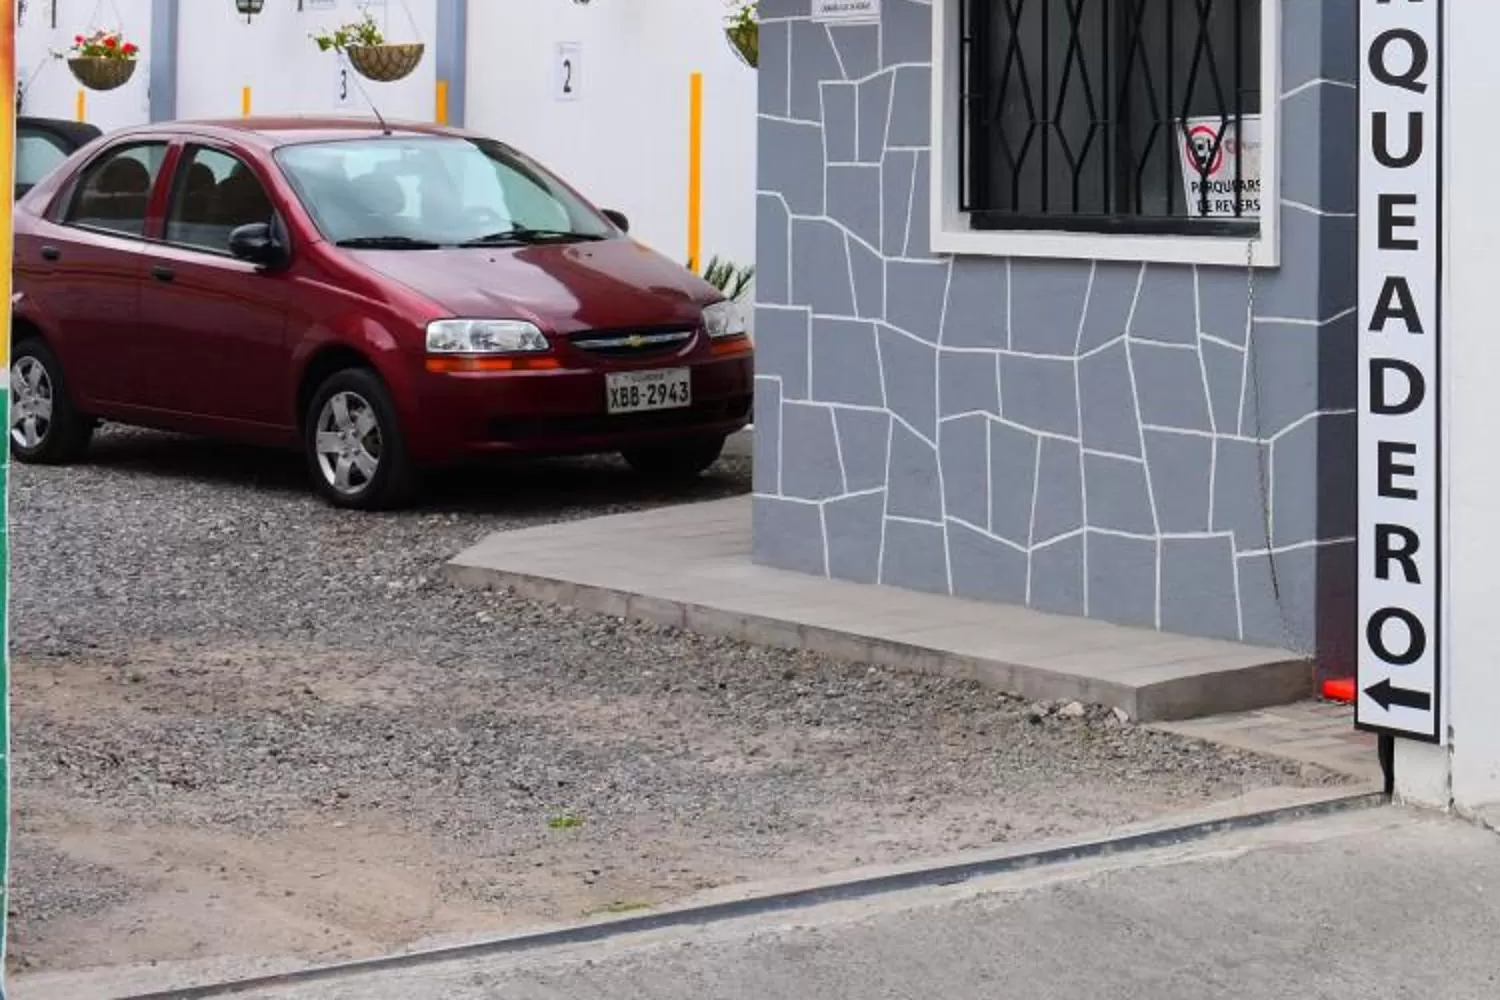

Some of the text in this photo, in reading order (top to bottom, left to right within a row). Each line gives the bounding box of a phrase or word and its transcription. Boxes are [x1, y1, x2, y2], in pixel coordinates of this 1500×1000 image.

[341, 69, 348, 101] 3
[563, 59, 572, 93] 2
[610, 381, 690, 409] XBB-2943
